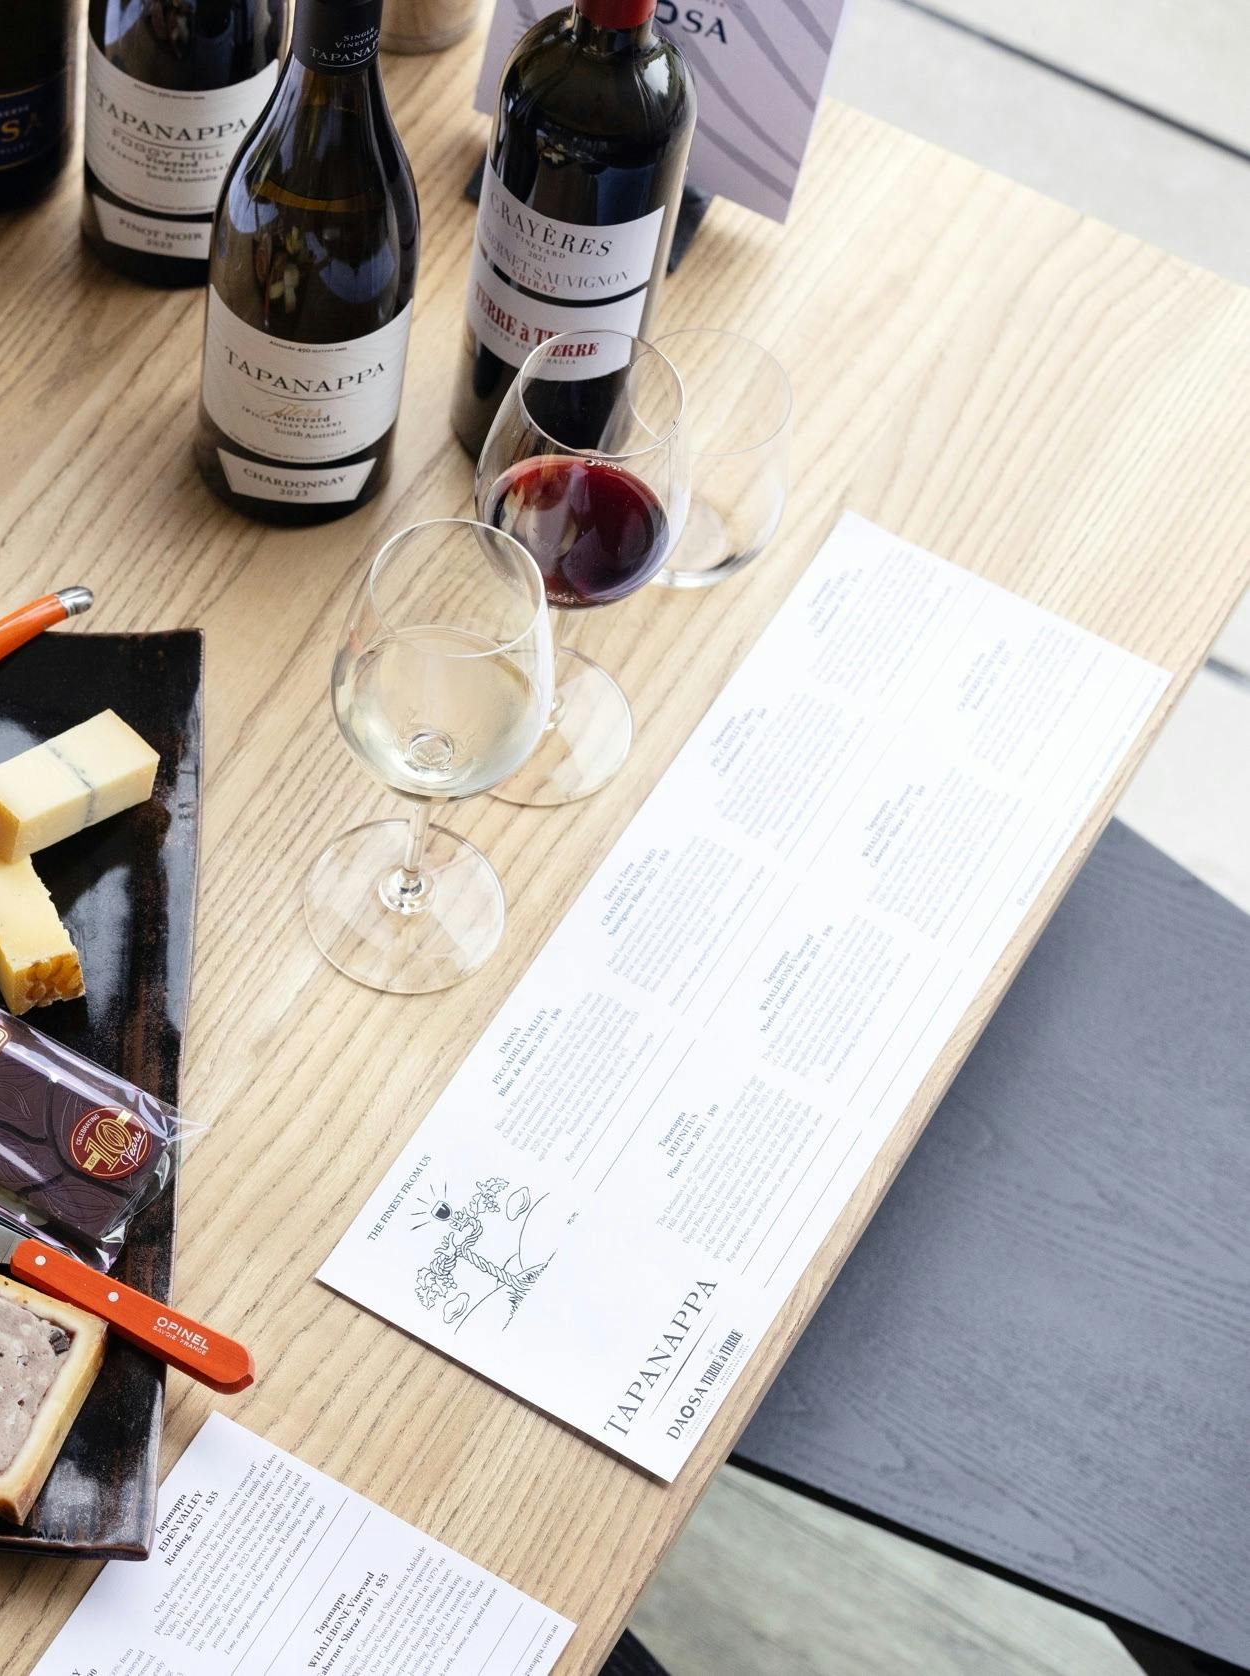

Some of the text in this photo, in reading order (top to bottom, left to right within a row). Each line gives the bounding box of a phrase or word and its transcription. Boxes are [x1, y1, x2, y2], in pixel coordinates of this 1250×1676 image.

[654, 0, 727, 45] OSA
[310, 37, 379, 61] TAPANAP
[95, 88, 248, 142] TAPANAPPA
[490, 191, 614, 258] CRAYÈRES
[225, 345, 385, 394] TAPANAPPA
[243, 467, 348, 489] CHARDONNAY
[498, 1026, 521, 1054] DAOSA
[497, 1077, 515, 1097] Blanc
[76, 1113, 100, 1146] CELEBRATING
[657, 1111, 686, 1147] Tapanappa
[666, 1114, 698, 1157] DEFINITUS
[666, 1158, 684, 1178] Pinot
[679, 1140, 695, 1158] Noir
[366, 1154, 431, 1240] THE FINEST FROM US
[156, 1316, 209, 1350] OPINEL
[604, 1281, 716, 1433] TAPANAPPA
[666, 1387, 707, 1439] DAOSA
[700, 1358, 724, 1385] TERRE
[718, 1328, 743, 1355] TERRE
[154, 1493, 187, 1535] Tapanappa
[157, 1490, 202, 1552] EDEN VALLEY
[163, 1490, 218, 1566] Riesling 2023 $35
[153, 1599, 179, 1635] philosophy
[244, 1478, 261, 1498] family
[261, 1453, 277, 1471] Eden
[161, 1572, 185, 1599] Riesling
[192, 1528, 214, 1558] exception
[189, 1572, 210, 1599] vineyard
[206, 1543, 230, 1574] identified
[240, 1500, 259, 1526] superior
[257, 1479, 274, 1501] quality
[307, 1571, 374, 1667] WHALEBONE Vineyard
[314, 1592, 346, 1634] Tapanappa
[340, 1617, 361, 1642] Shiraz
[357, 1596, 373, 1616] 2018
[375, 1572, 389, 1588] $55
[406, 1591, 424, 1618] planted
[524, 1624, 558, 1676] panappa.com.au
